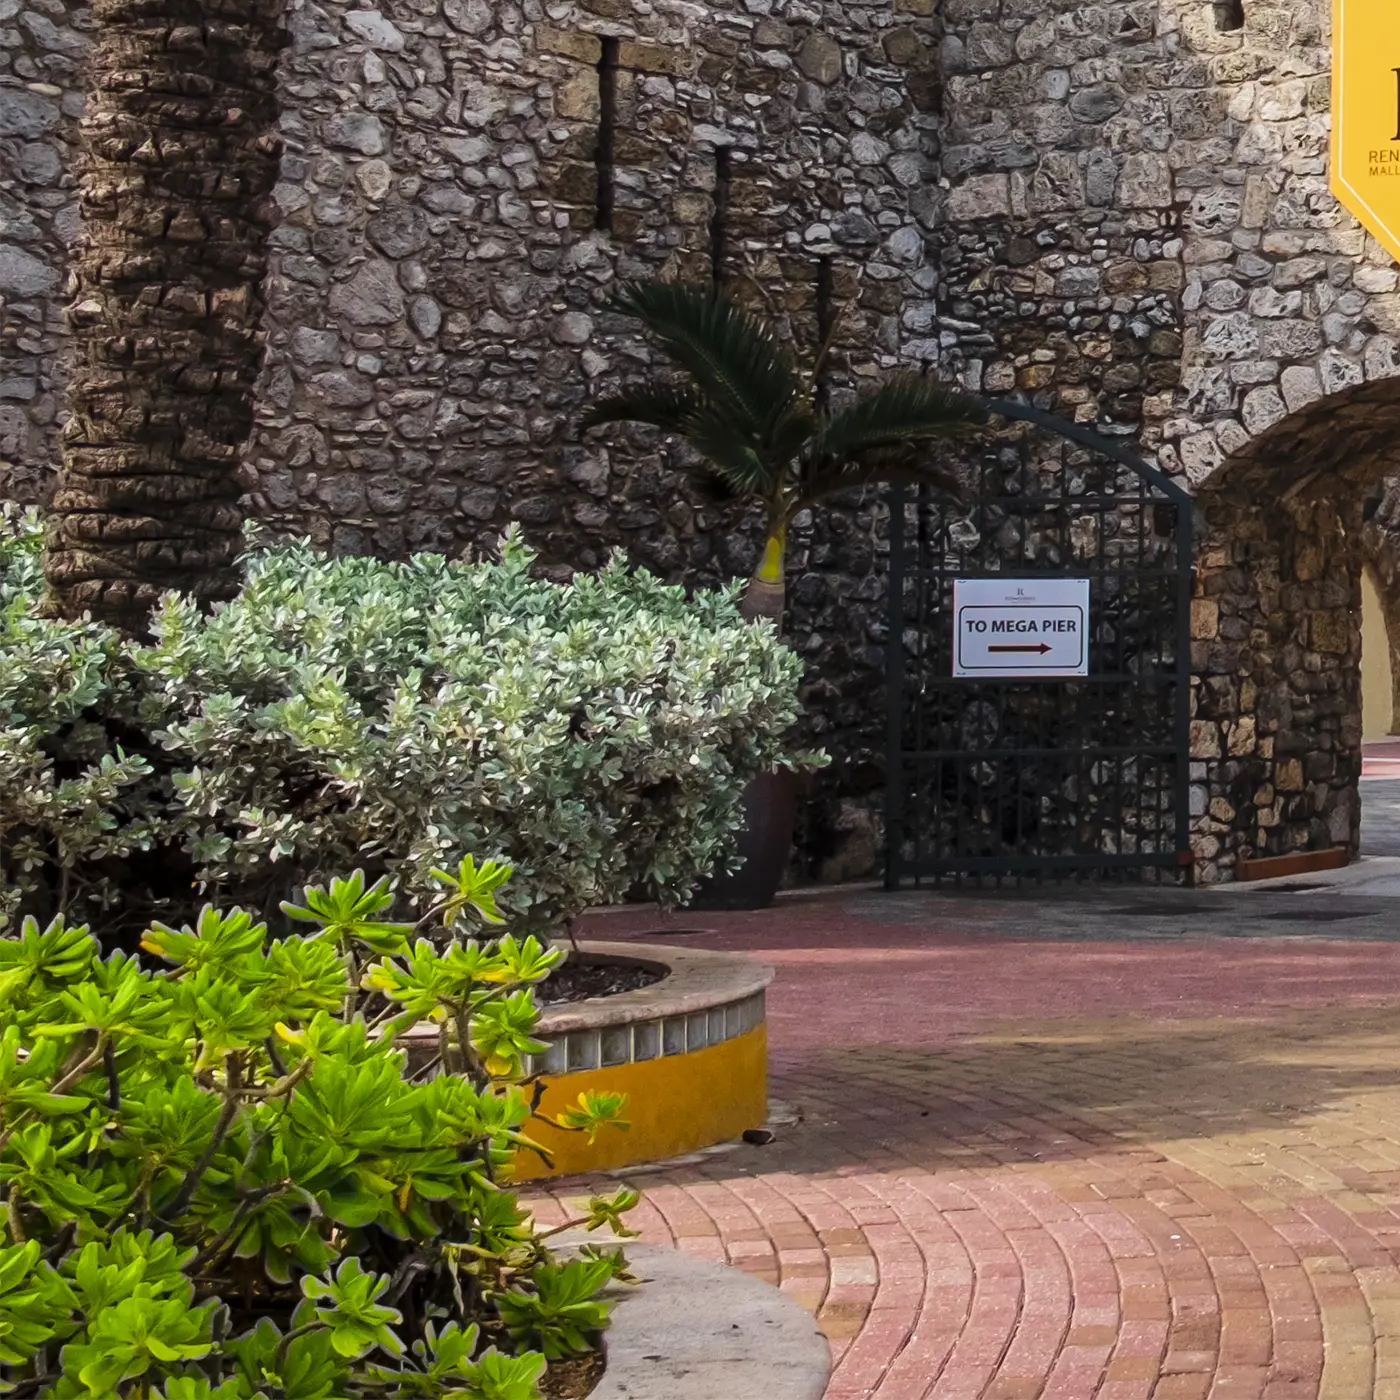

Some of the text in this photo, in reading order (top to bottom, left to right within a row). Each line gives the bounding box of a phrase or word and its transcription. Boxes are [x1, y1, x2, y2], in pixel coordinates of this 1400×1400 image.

[1369, 165, 1400, 177] MALL
[965, 619, 1077, 633] TO MEGA PIER
